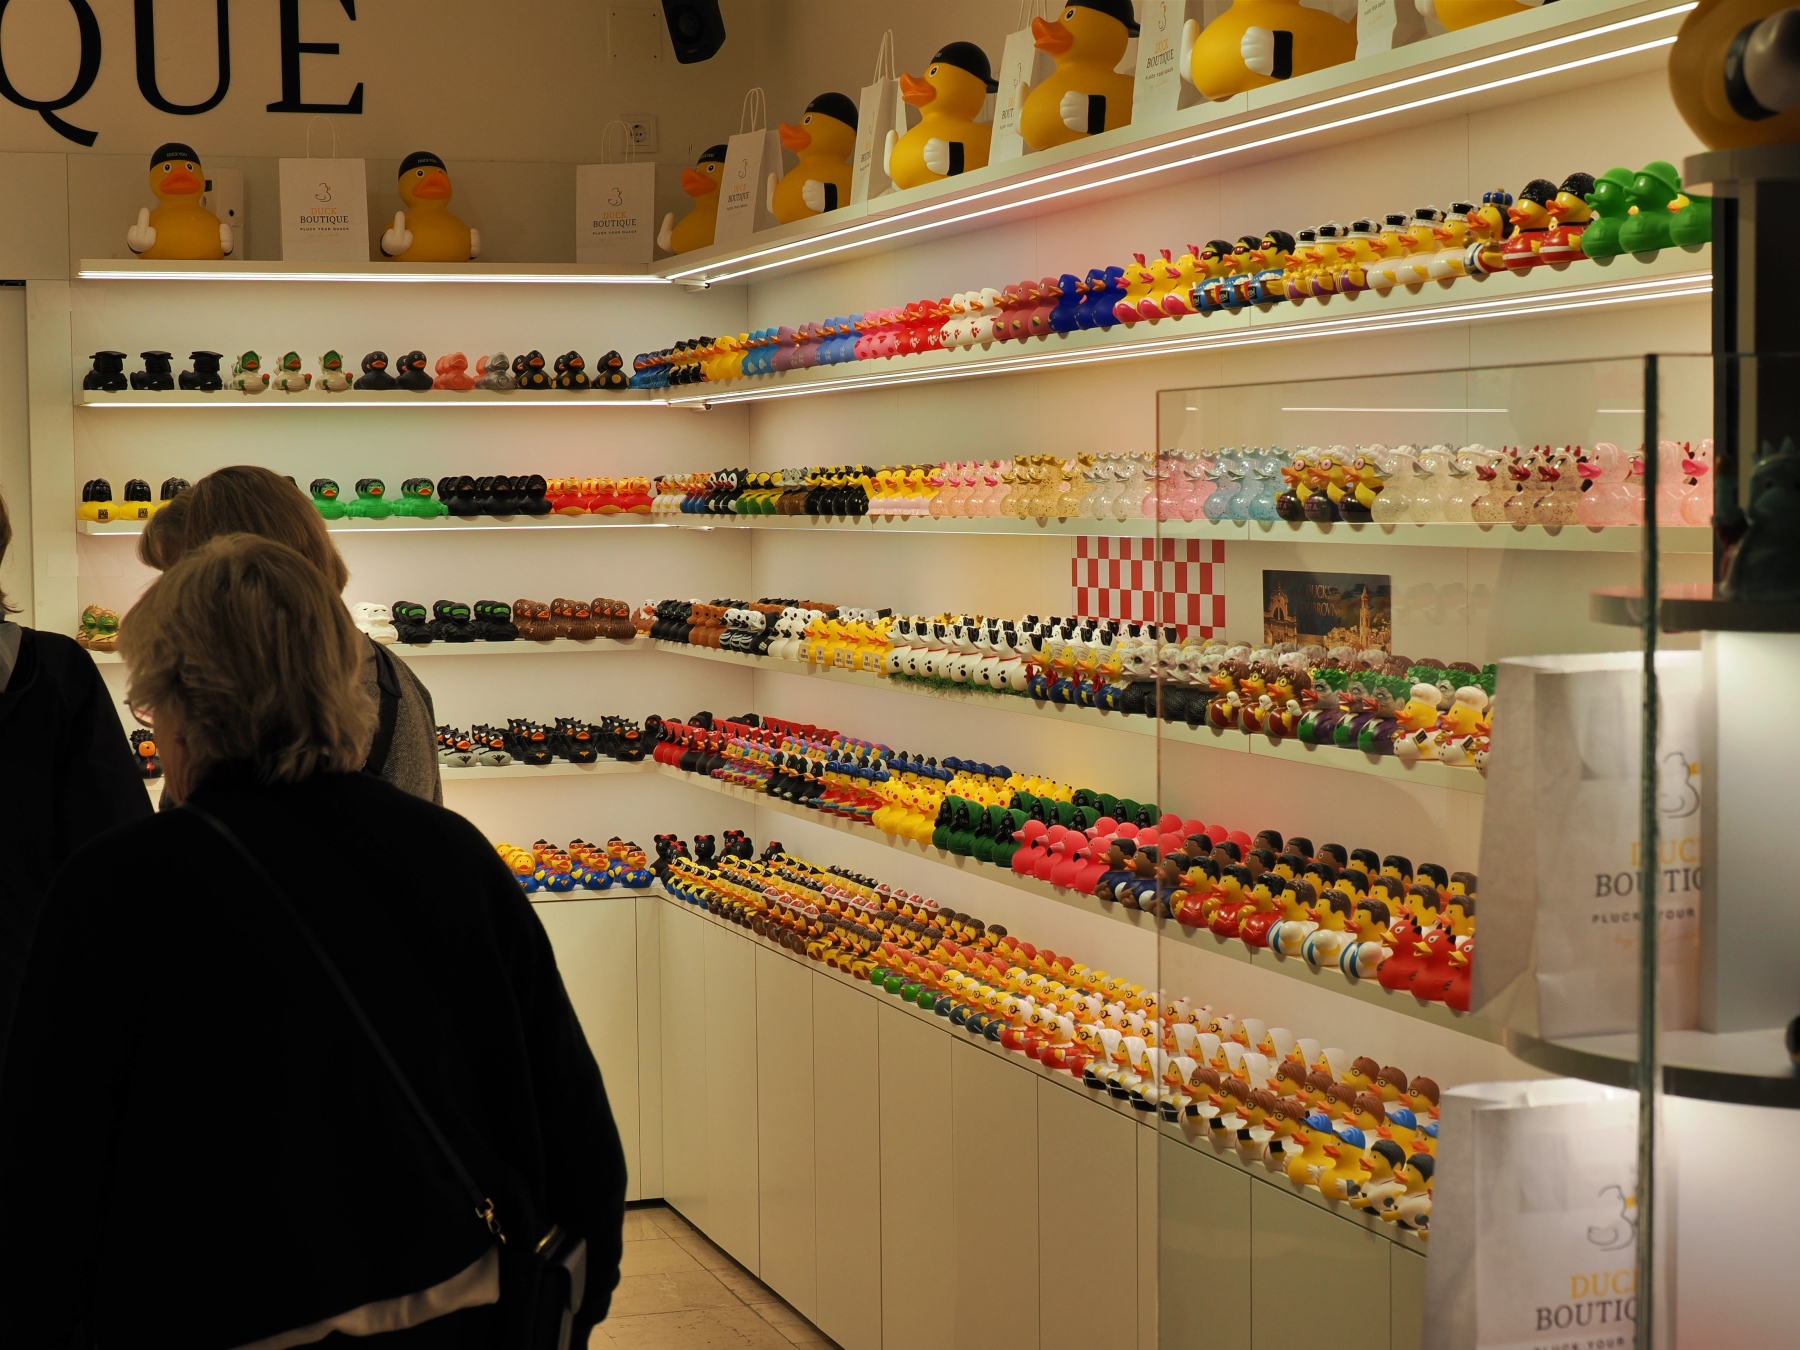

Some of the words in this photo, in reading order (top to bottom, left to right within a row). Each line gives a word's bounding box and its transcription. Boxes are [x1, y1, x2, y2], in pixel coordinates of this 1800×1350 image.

[1146, 48, 1175, 69] BOUTIQUE
[0, 0, 364, 147] QUE
[311, 207, 337, 215] DUCK
[603, 211, 627, 219] DUCK
[300, 215, 349, 225] BOUTIQUE
[592, 219, 637, 228] BOUTIQUE
[1630, 837, 1700, 867] UC
